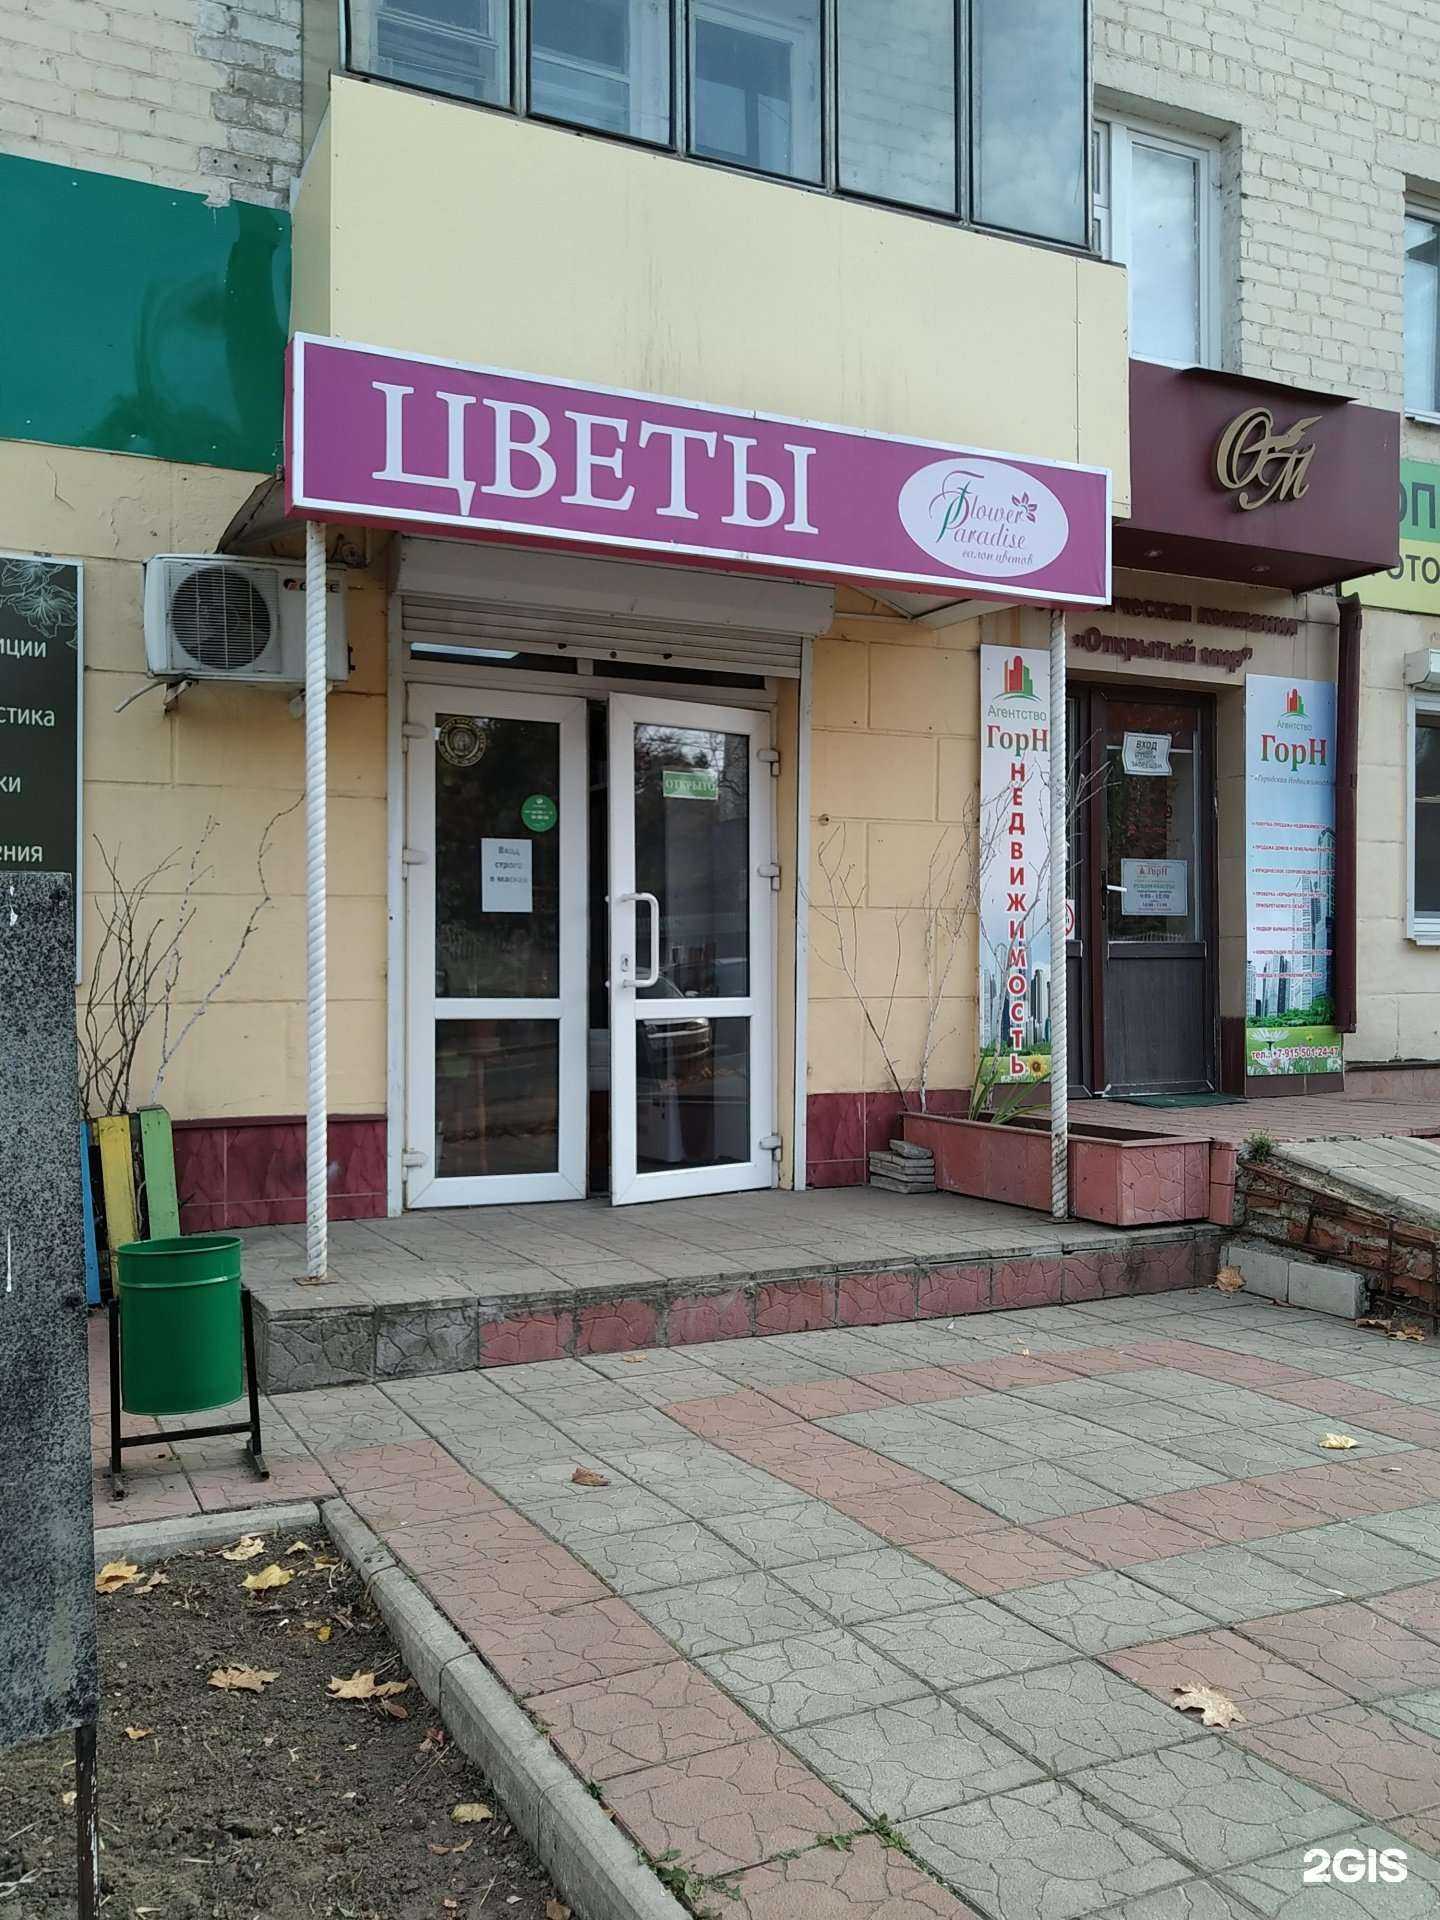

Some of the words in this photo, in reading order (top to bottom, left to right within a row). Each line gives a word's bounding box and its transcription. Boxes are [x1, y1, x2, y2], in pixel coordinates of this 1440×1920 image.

[371, 381, 820, 535] ЦВЕТЫ
[942, 470, 1024, 525] Flower
[1400, 480, 1436, 529] П
[929, 490, 1027, 550] Paradise
[0, 638, 47, 659] ции
[987, 704, 1047, 722] Агентство
[1277, 719, 1313, 732] Агентство
[987, 724, 1049, 757] ГорН
[1260, 734, 1327, 772] ГорН
[0, 845, 43, 863] ния
[1006, 762, 1027, 1076] НЕДВИЖИМОСТЬ
